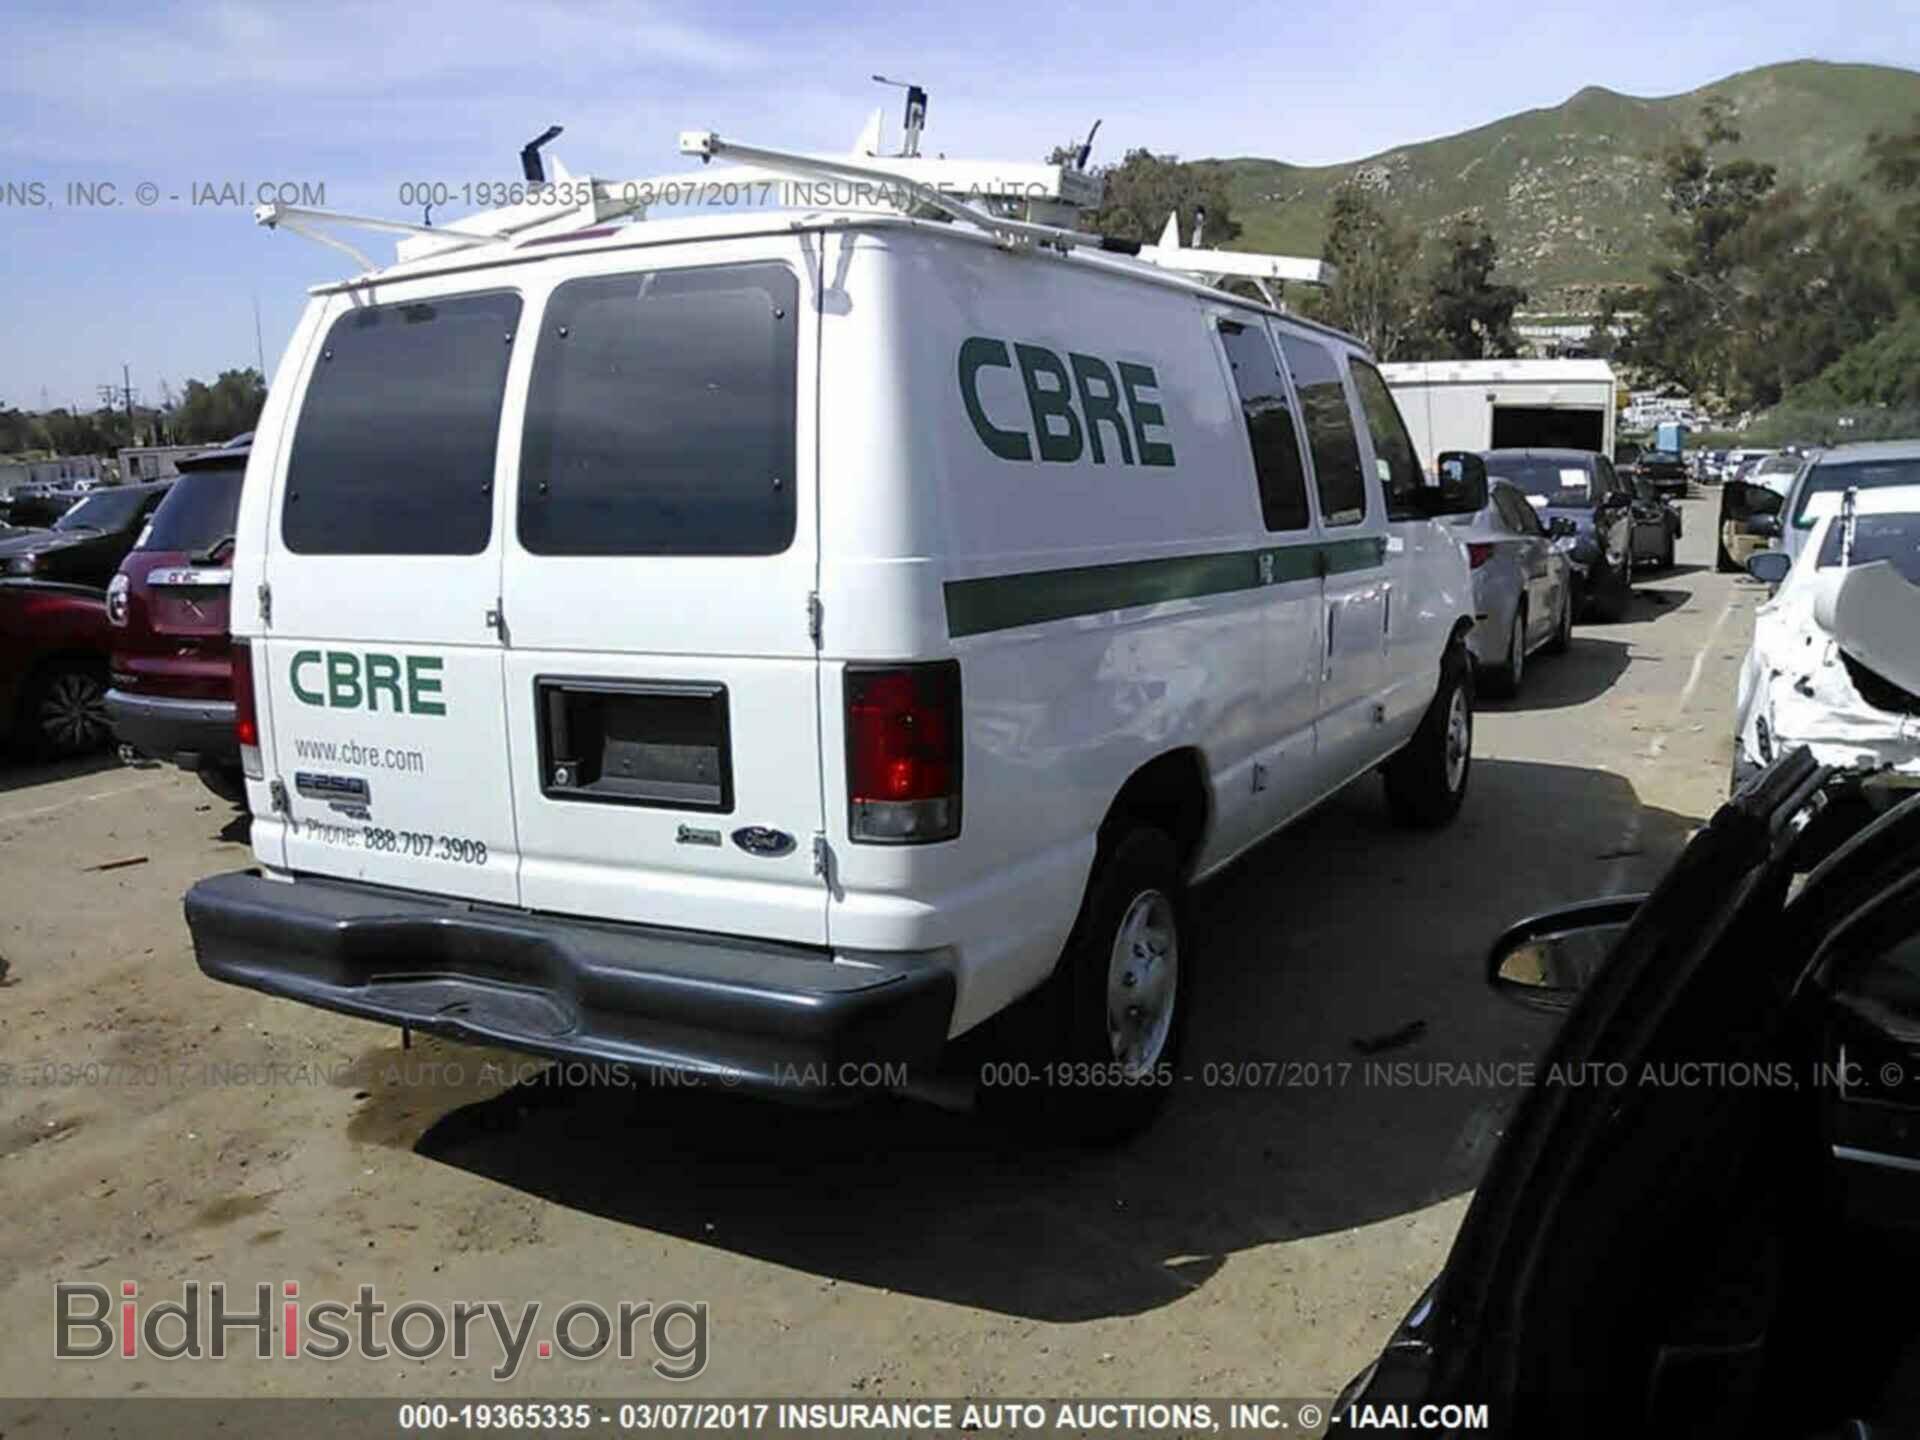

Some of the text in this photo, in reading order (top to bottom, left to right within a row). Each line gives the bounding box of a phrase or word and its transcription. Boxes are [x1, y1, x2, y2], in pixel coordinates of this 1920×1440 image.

[958, 336, 1176, 466] CBRE
[290, 650, 447, 716] CBRE
[295, 738, 424, 772] www.cbre.com
[362, 825, 488, 866] 888.707.3908
